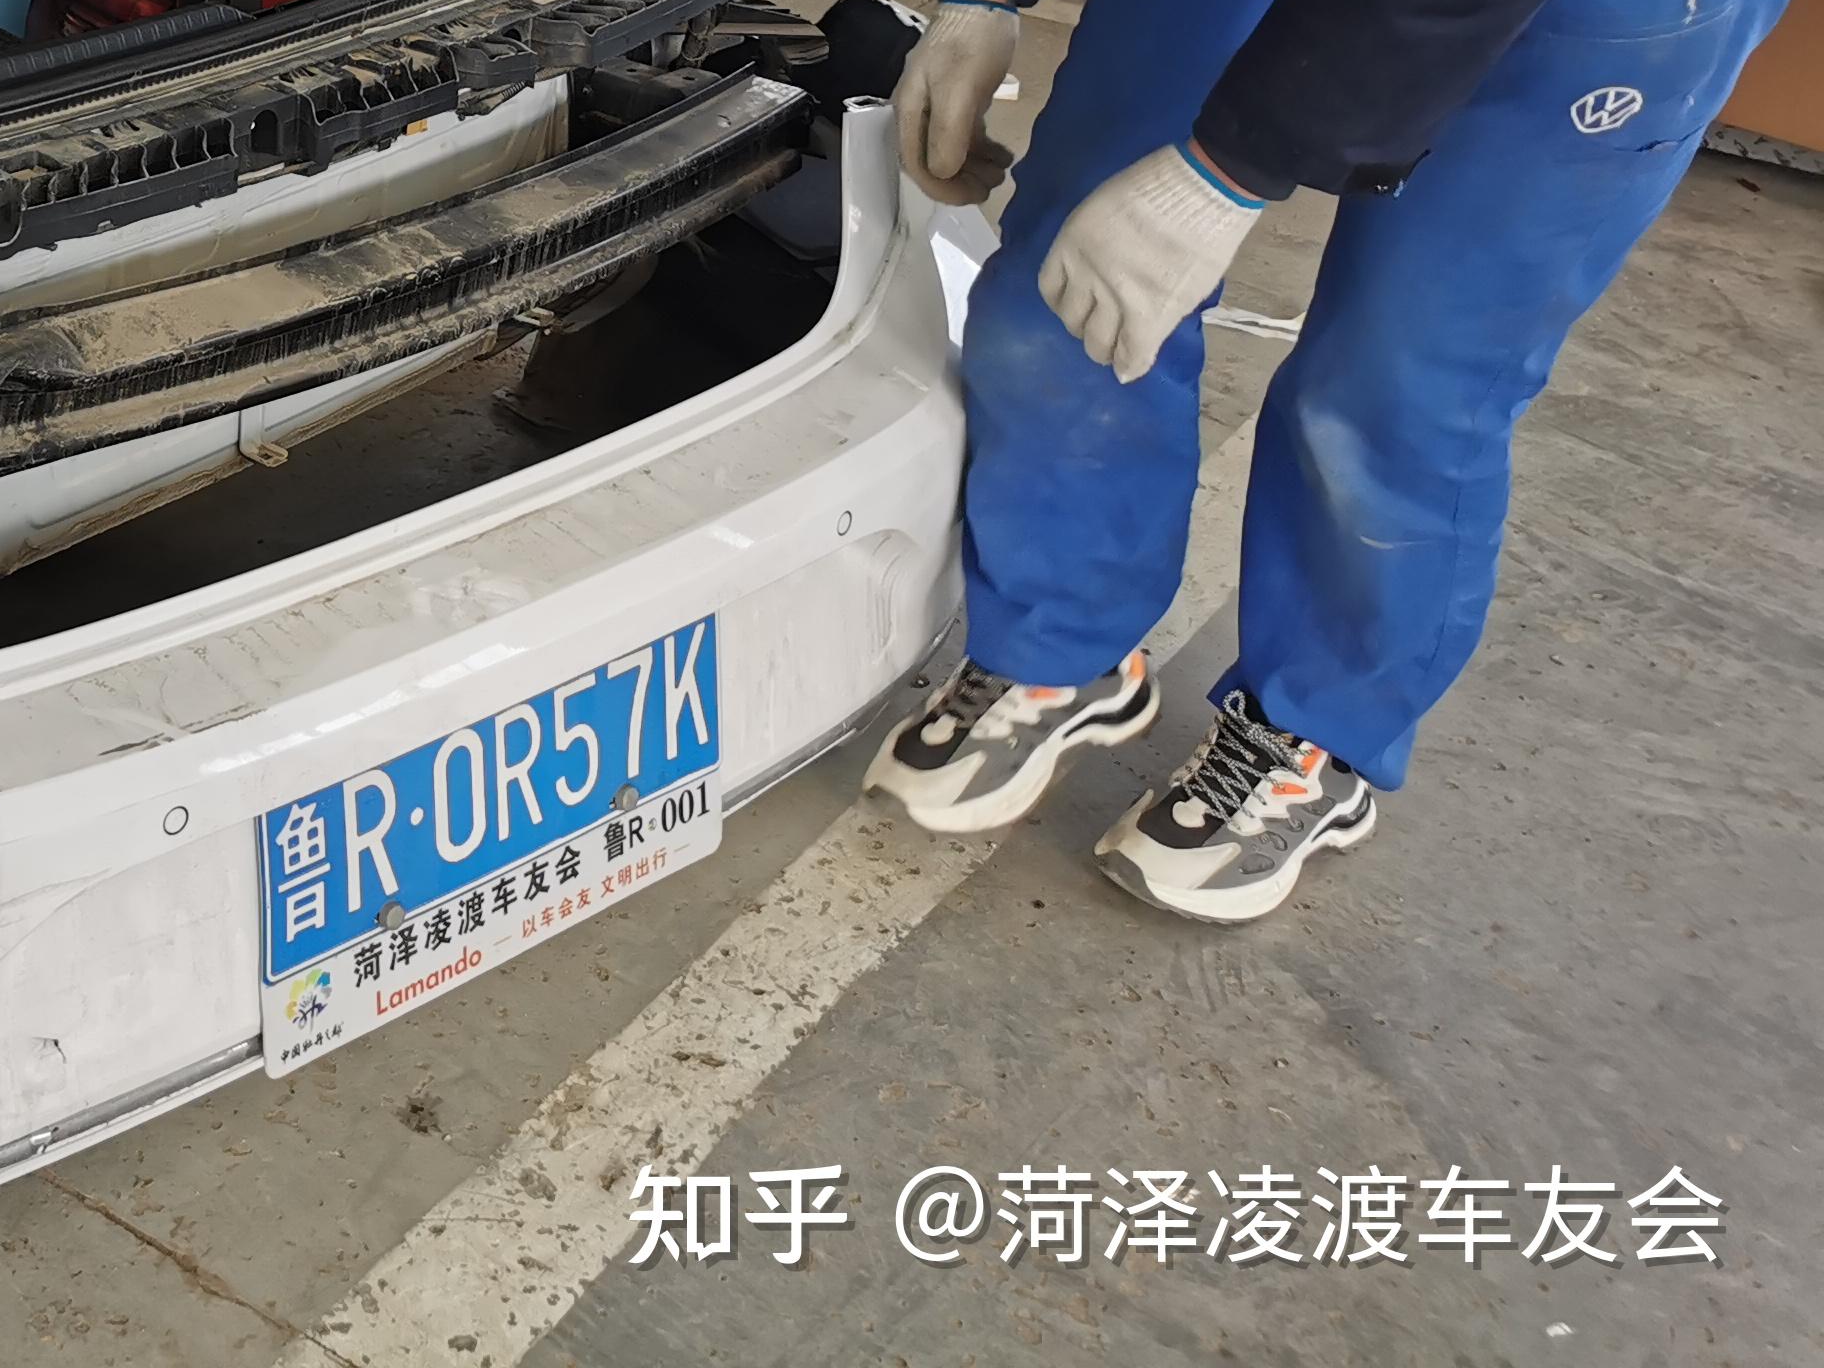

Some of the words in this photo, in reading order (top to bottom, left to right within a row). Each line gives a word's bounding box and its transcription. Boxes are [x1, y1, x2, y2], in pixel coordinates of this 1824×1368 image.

[353, 845, 582, 988] 菏泽凌渡车友会
[521, 887, 592, 939] 以车会友
[600, 846, 668, 899] 文明出行
[375, 945, 483, 1017] Lamando
